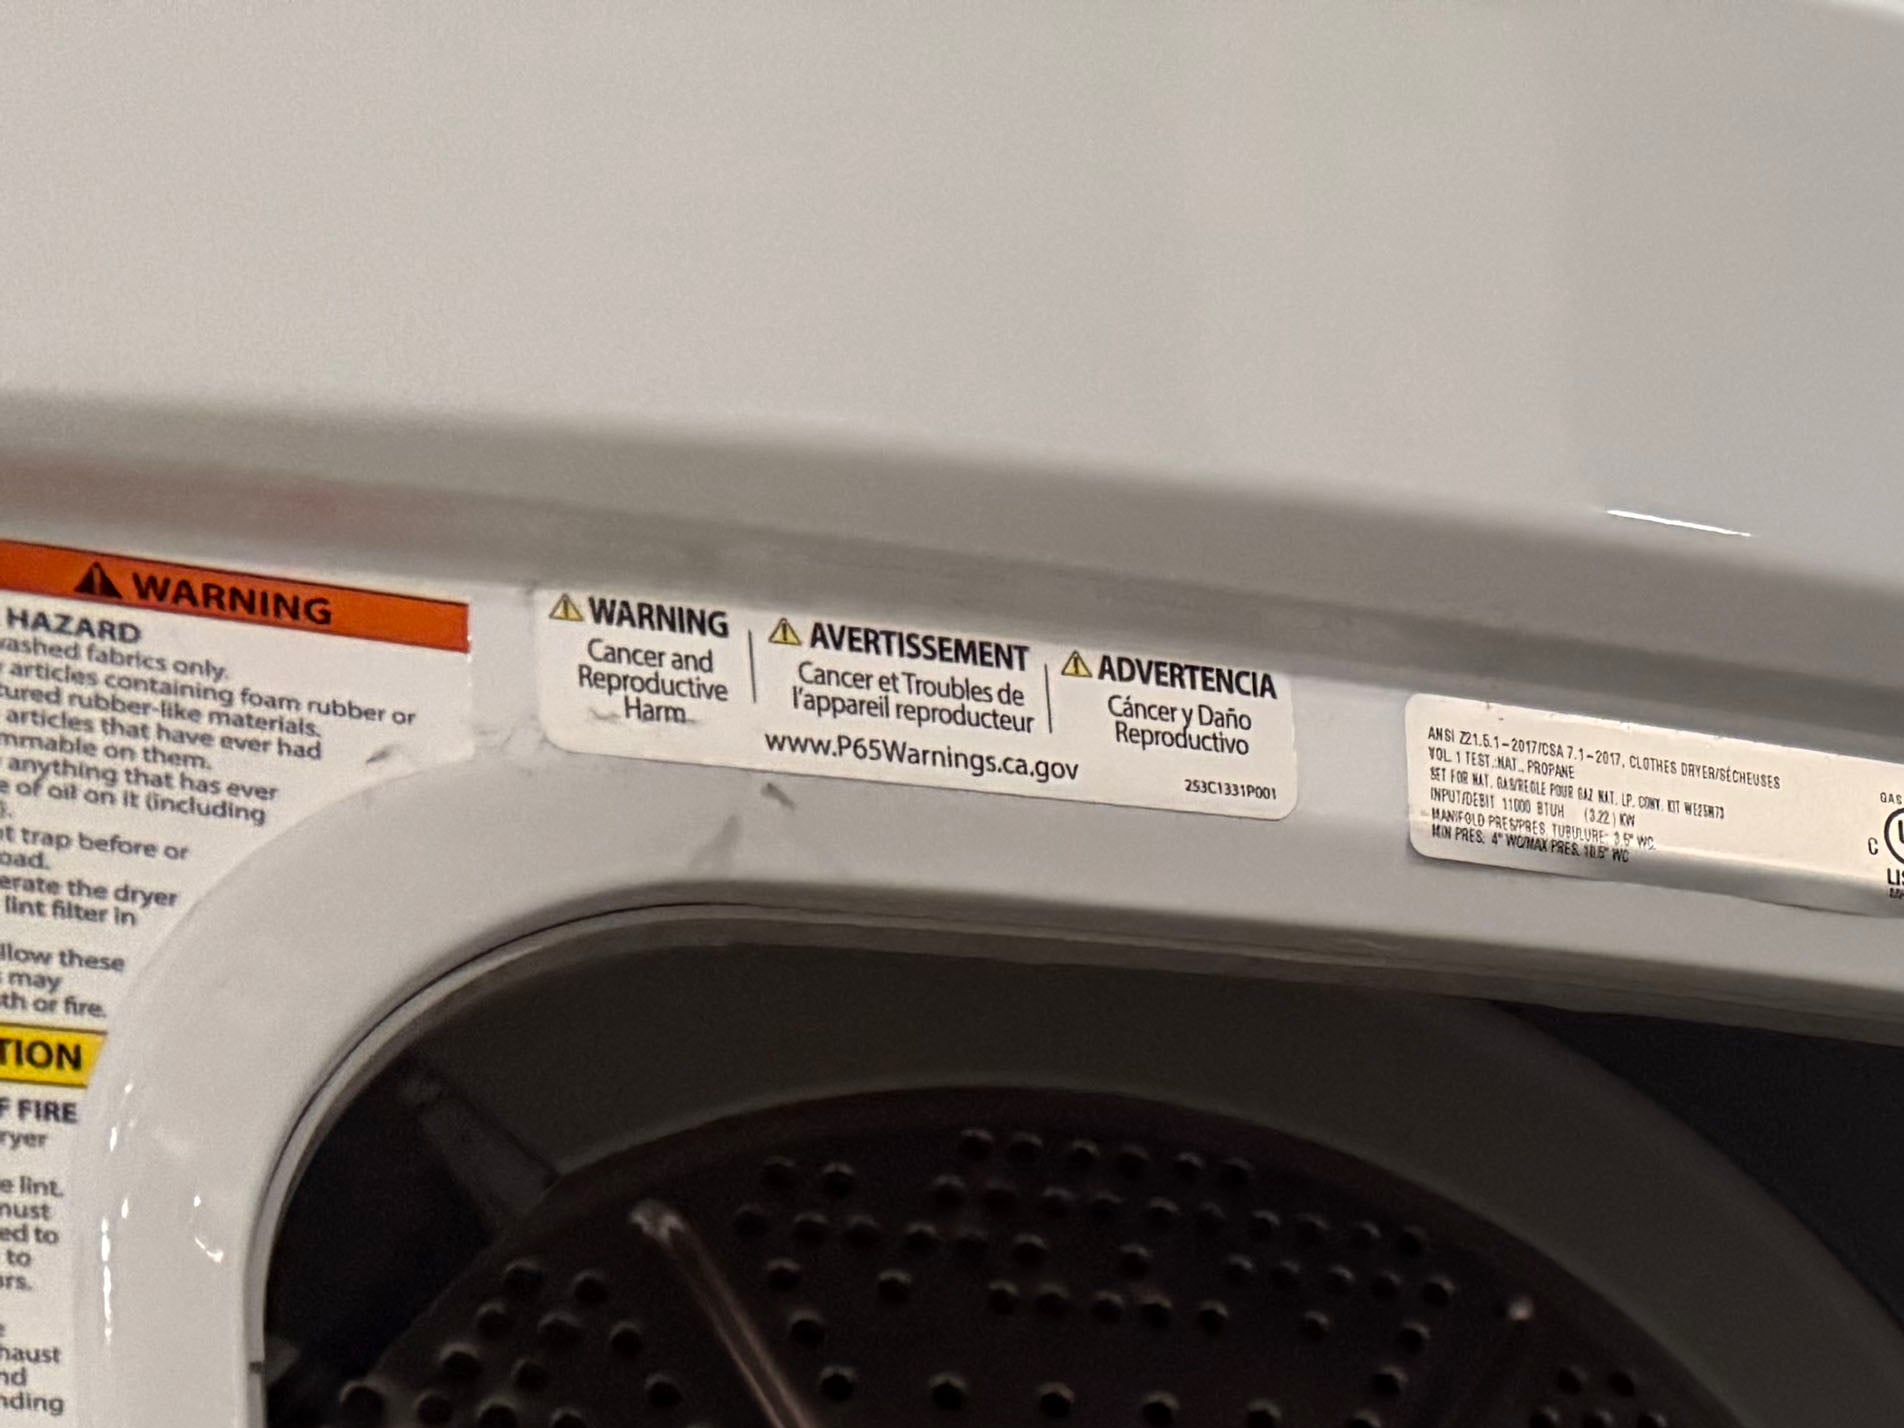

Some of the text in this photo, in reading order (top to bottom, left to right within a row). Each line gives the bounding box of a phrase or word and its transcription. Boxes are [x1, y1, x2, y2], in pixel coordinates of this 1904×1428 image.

[132, 572, 333, 625] WARNING
[588, 596, 729, 639] WARNING
[7, 608, 142, 644] HAZARD
[86, 645, 167, 672] fabrics
[586, 638, 714, 674] Cancer and
[809, 622, 1029, 672] AVERTISSEMENT
[10, 663, 416, 725] articles containing foam rubber or
[578, 664, 728, 704] Reproductive
[798, 662, 1024, 707] Cancer et Troubles de
[1096, 654, 1278, 701] ADVERTENCIA
[69, 693, 199, 722] rubber-like
[895, 698, 1034, 735] reproducteur
[1106, 693, 1252, 732] Cáncer y Daño
[6, 710, 321, 760] articles that have ever had
[1114, 721, 1250, 759] Reproductivo
[1428, 726, 1455, 742] ANSI
[764, 732, 1079, 784] www.P65Warnings.ca.gov
[1629, 755, 1677, 774] CLOTHES
[22, 828, 156, 859] trap before
[114, 884, 177, 908] dryer
[18, 1098, 77, 1124] FIRE
